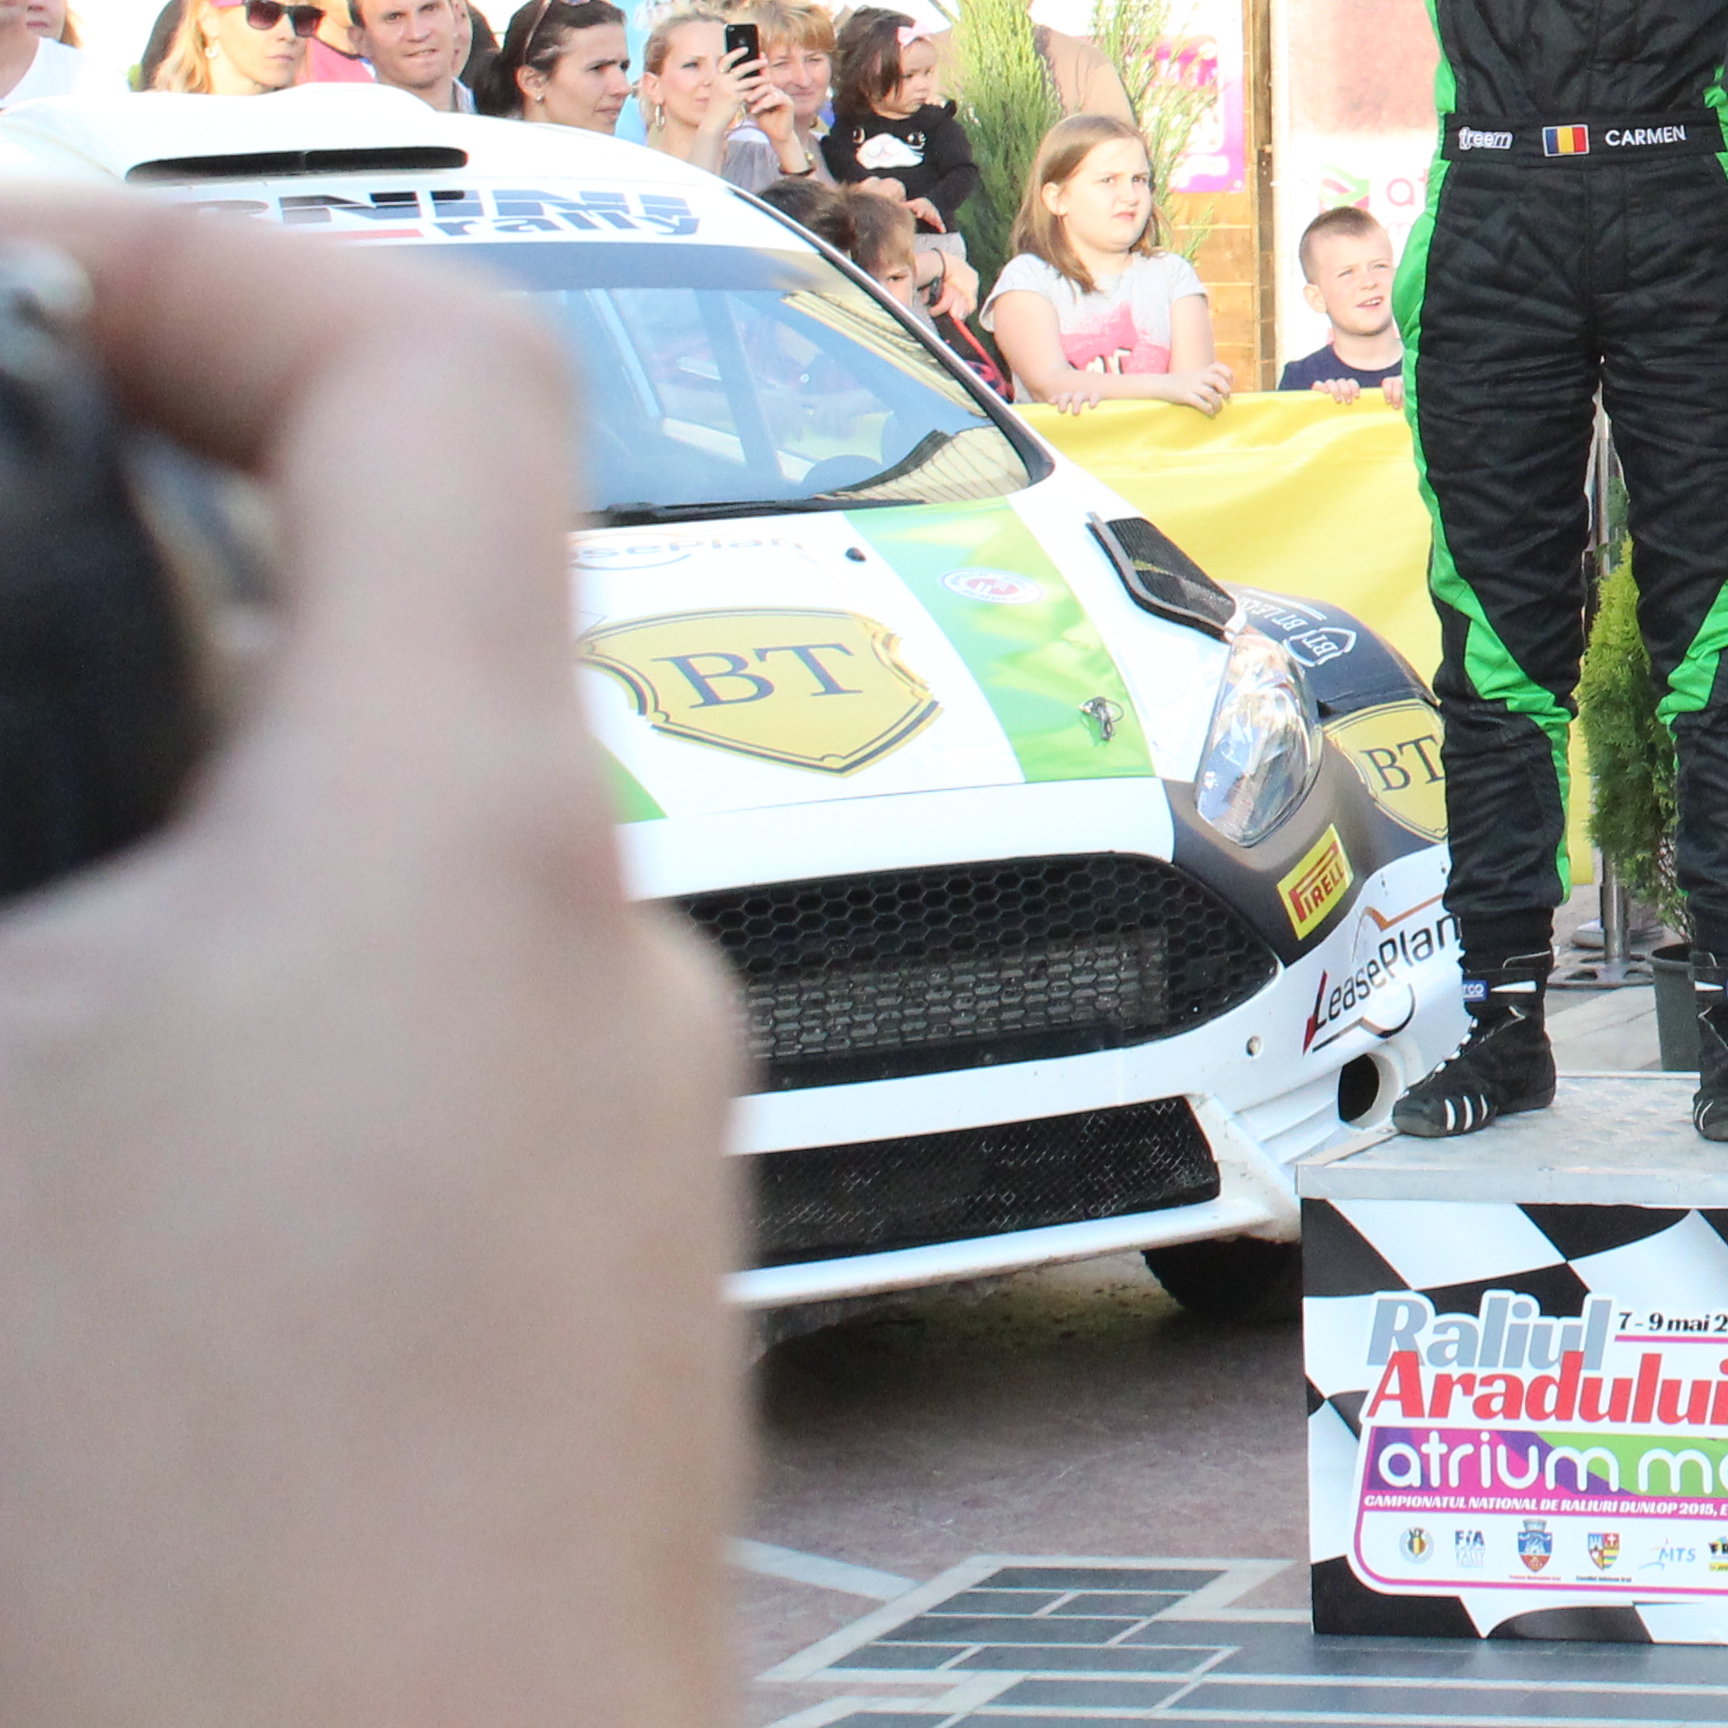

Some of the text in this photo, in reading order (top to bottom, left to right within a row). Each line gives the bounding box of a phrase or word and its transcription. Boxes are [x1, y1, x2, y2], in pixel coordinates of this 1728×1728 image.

[1459, 125, 1686, 150] freem CARMEN
[433, 209, 701, 237] rally
[1302, 634, 1340, 658] BT
[650, 642, 863, 709] BT
[1360, 734, 1446, 791] BT
[1314, 912, 1461, 1029] LeasePlan
[1366, 1295, 1614, 1370] Raliul
[1618, 1312, 1631, 1331] 7
[1649, 1313, 1663, 1331] 9
[1667, 1313, 1711, 1333] mai
[1377, 1430, 1621, 1493] atrium
[1364, 1495, 1467, 1510] CAMPIONATUL
[1468, 1496, 1538, 1511] NATIONAL
[1540, 1499, 1559, 1511] DE
[1560, 1499, 1618, 1513] RALIURI
[1619, 1501, 1679, 1514] DUNLOP
[1679, 1502, 1718, 1517] 2015,
[1658, 1547, 1696, 1563] MTS
